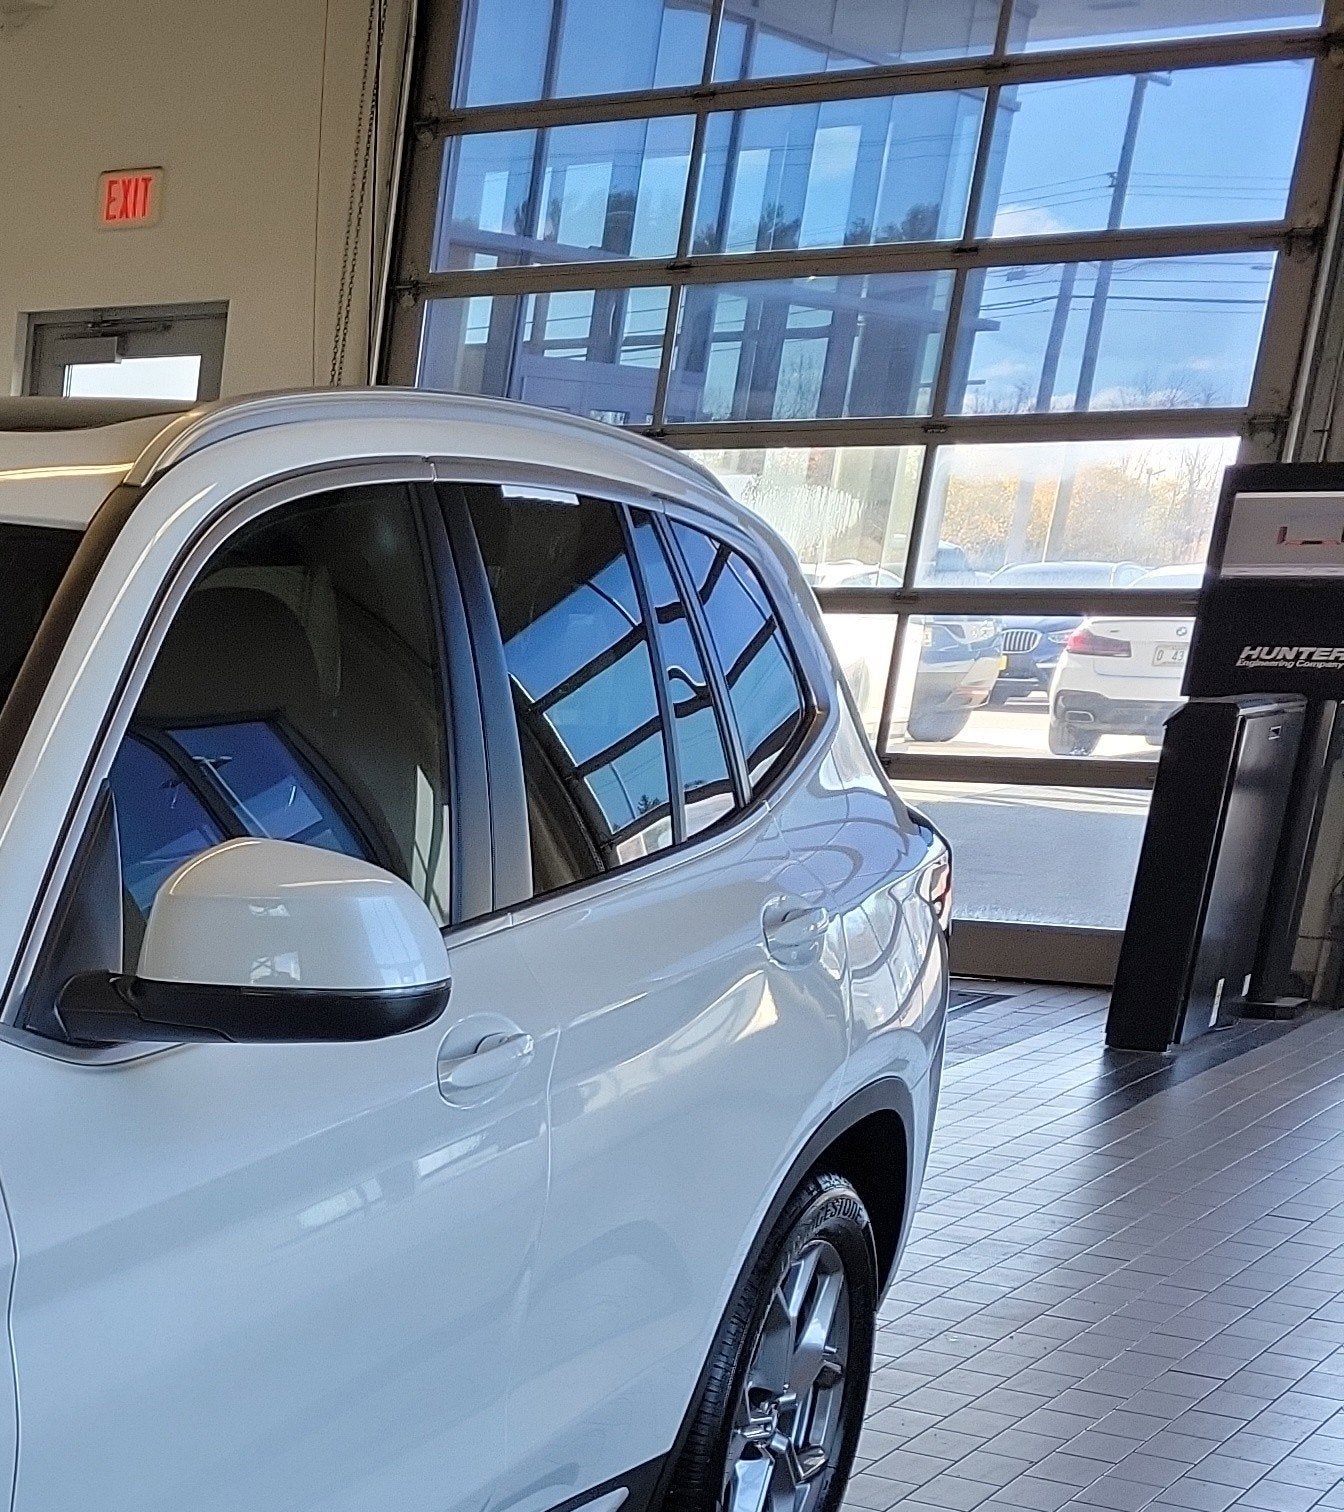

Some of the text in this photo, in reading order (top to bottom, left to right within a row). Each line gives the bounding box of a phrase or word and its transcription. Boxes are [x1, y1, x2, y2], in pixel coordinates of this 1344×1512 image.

[105, 177, 153, 220] EXIT
[1237, 646, 1344, 661] HUNTER
[1236, 659, 1344, 669] Engineering Company
